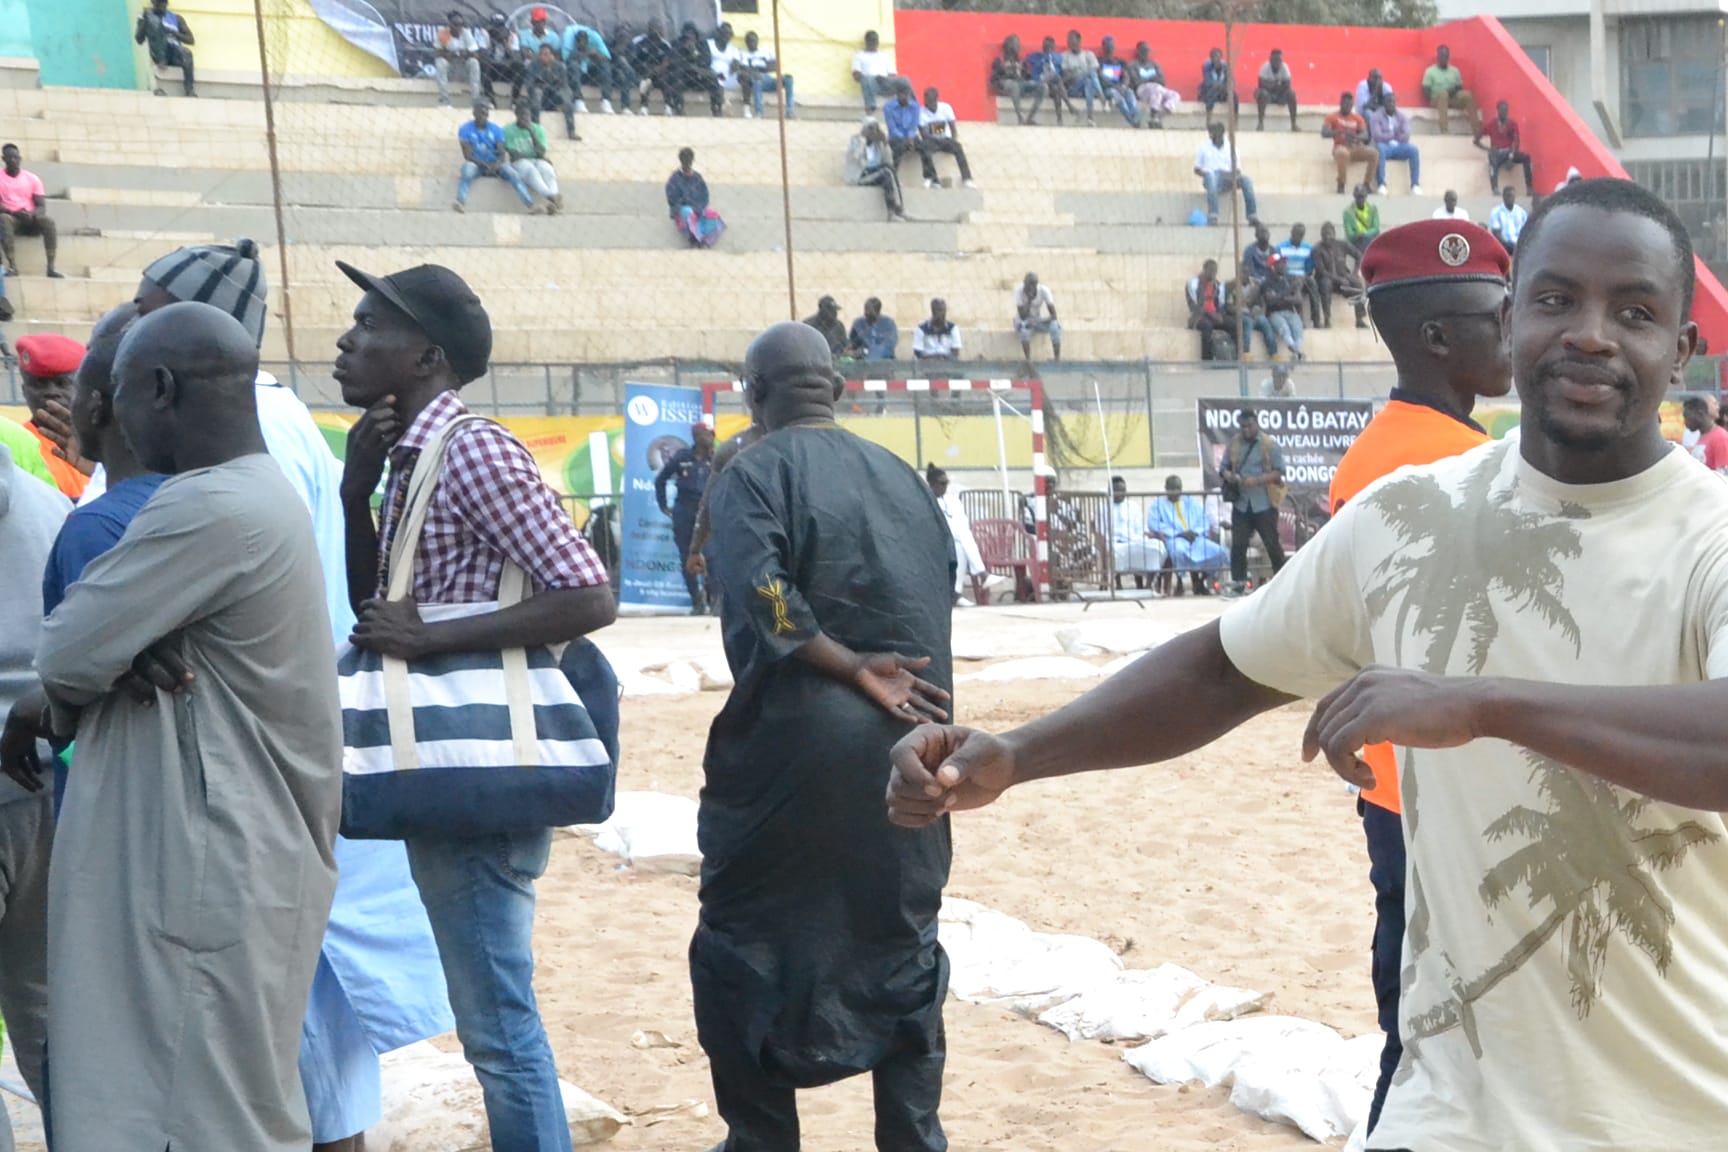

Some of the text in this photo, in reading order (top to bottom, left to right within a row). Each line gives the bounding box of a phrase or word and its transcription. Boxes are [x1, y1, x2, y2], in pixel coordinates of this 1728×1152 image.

[1205, 405, 1369, 429] NDOGO LÔ BATAY
